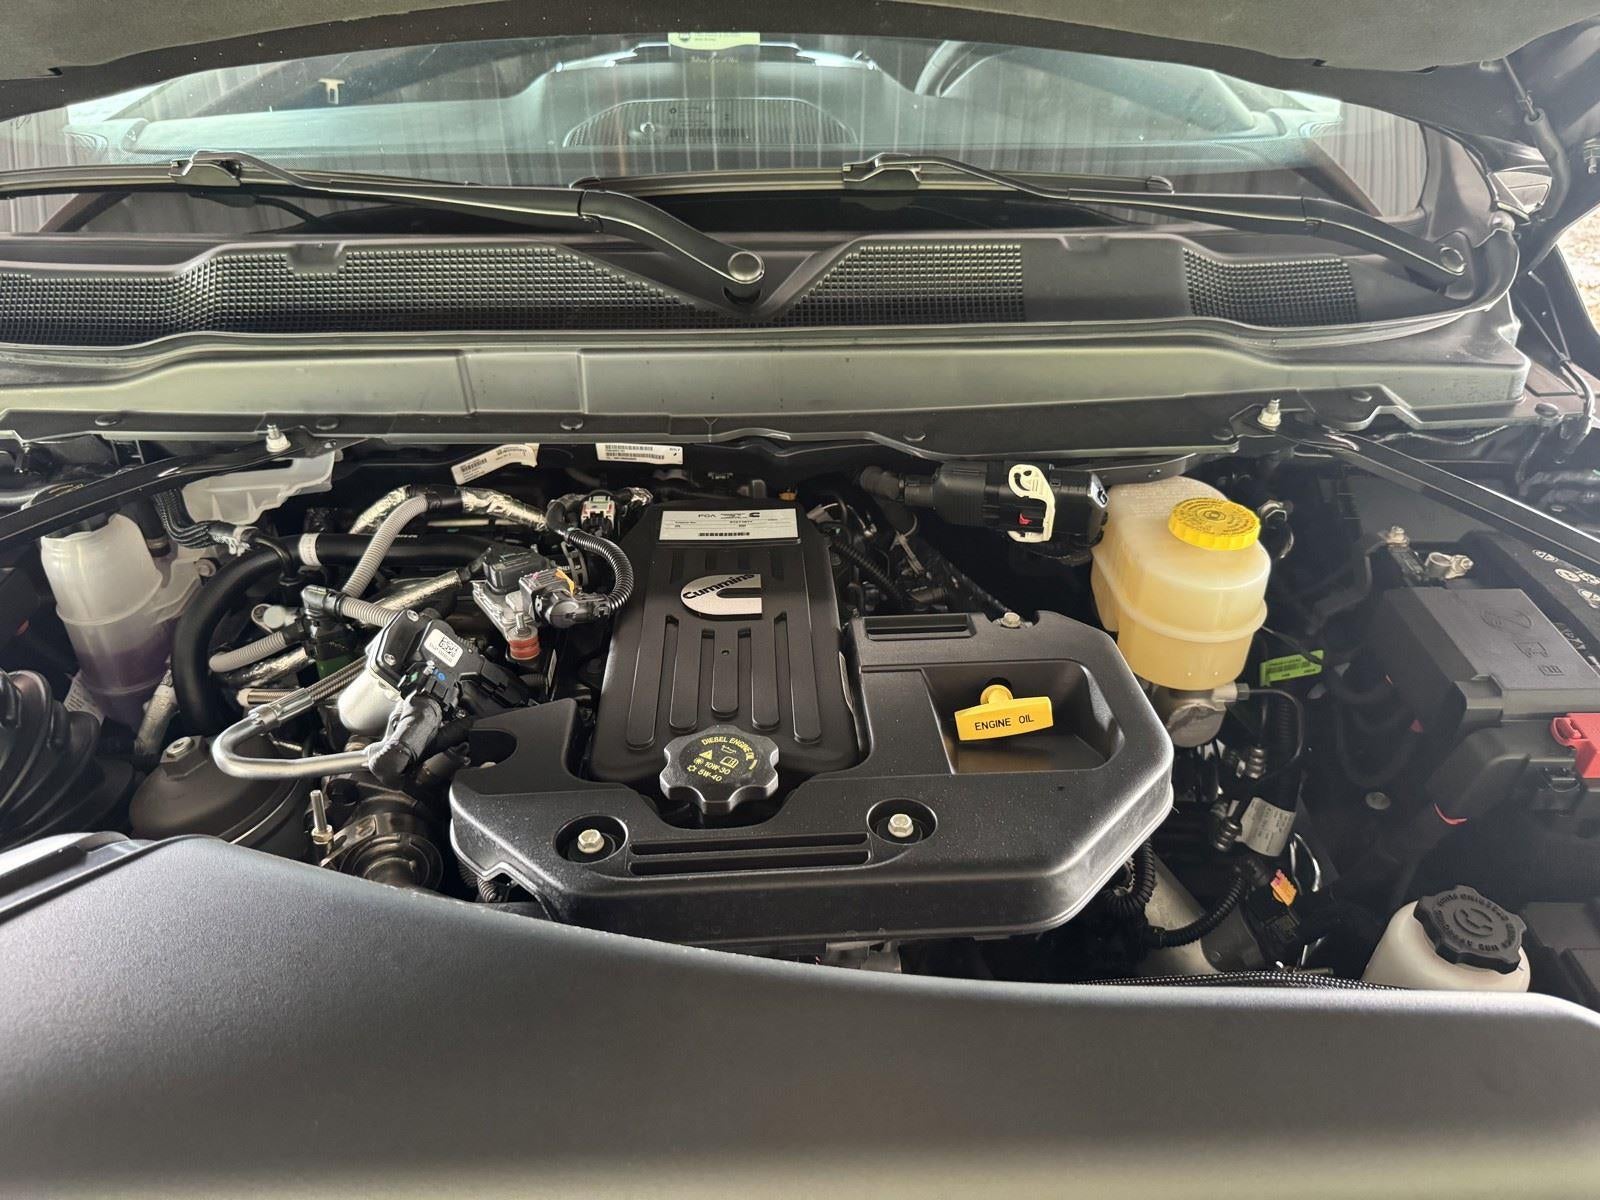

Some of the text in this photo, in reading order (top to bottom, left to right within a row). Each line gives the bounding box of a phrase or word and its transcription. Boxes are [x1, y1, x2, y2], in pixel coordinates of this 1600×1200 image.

[682, 573, 755, 600] Cummins
[974, 714, 1034, 731] ENGINE OIL
[701, 736, 728, 745] DIESEL
[729, 737, 753, 753] ENGINE
[697, 768, 723, 782] 5W-40
[704, 761, 731, 775] 10W-30
